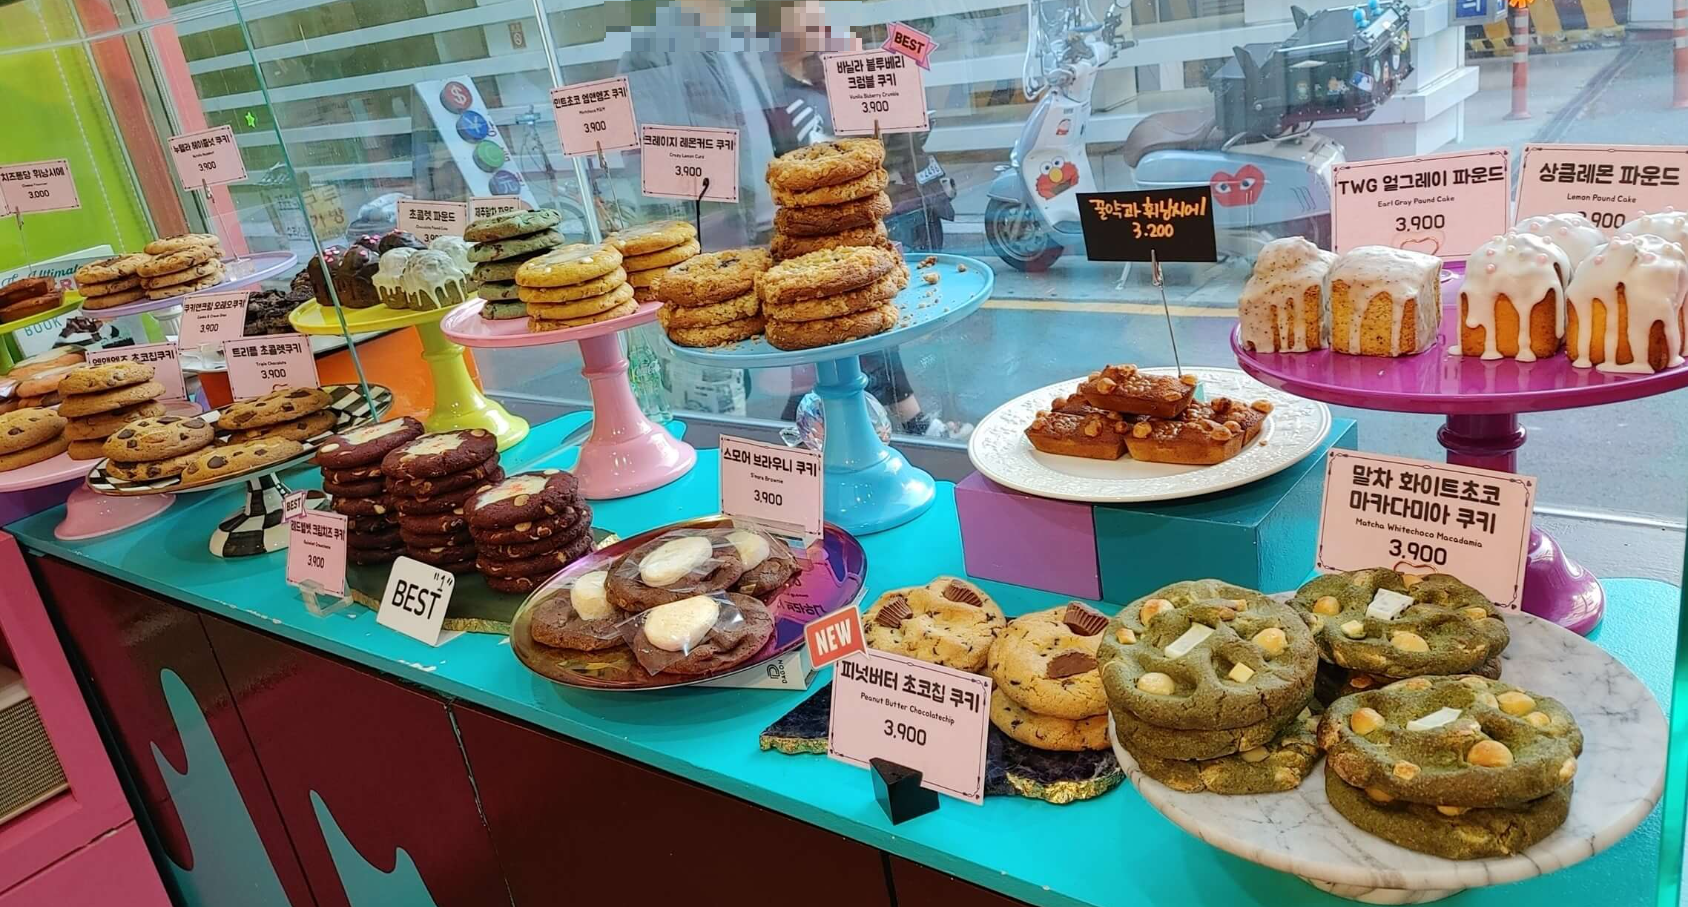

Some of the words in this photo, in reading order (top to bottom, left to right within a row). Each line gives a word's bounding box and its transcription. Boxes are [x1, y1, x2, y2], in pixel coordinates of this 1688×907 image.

[894, 32, 925, 54] BEST
[837, 59, 863, 74] 바닐라
[866, 55, 905, 72] 블루베리
[847, 76, 875, 89] 크럼블
[878, 73, 897, 87] 쿠키
[612, 87, 627, 99] 쿠키
[861, 100, 889, 113] 3.900
[584, 120, 606, 133] 3.900
[215, 134, 231, 144] 쿠키
[643, 135, 677, 147] 크레이지
[680, 137, 714, 149] 레몬커드
[716, 139, 733, 151] 쿠키
[33, 167, 65, 178] 휘낭시에
[198, 161, 216, 171] 3.900
[675, 165, 702, 177] 3.900
[1539, 163, 1614, 185] 상큼레몬
[1618, 165, 1680, 186] 파운드
[1338, 178, 1378, 195] TWG
[1382, 170, 1447, 192] 얼그레이
[1453, 166, 1505, 185] 파운드
[28, 190, 50, 199] 3.000
[1567, 193, 1591, 201] Lemon
[1592, 194, 1616, 202] Pound
[1617, 195, 1637, 203] Cake
[409, 208, 432, 221] 초콜렛
[433, 210, 456, 222] 파운드
[1089, 199, 1141, 220] 꿀약과
[1142, 196, 1207, 221] 휘낭시에
[1132, 221, 1174, 239] 3.200
[1395, 214, 1445, 232] 3.900
[200, 323, 219, 333] 3.900
[231, 346, 258, 357] 트리플
[261, 369, 287, 379] 3.900
[723, 447, 751, 465] 스모어
[753, 453, 792, 473] 브라우니
[796, 460, 817, 477] 쿠키
[1352, 464, 1393, 489] 말차
[1398, 471, 1501, 507] 화이트초코
[286, 497, 302, 512] BEST
[754, 489, 783, 506] 3.900
[1349, 490, 1451, 525] 마카다미아
[1456, 507, 1496, 535] 쿠키
[312, 524, 333, 539] 크림치즈
[334, 528, 345, 541] 쿠키
[1355, 517, 1385, 530] Matcha
[1388, 523, 1435, 539] Whitechoco
[1436, 532, 1483, 548] Macadamia
[1389, 538, 1448, 566] 3.900
[307, 554, 324, 569] 3.900
[391, 579, 442, 620] BEST
[814, 618, 852, 658] NEW
[840, 660, 898, 691] 피넛버터
[902, 674, 946, 704] 초코칩
[949, 687, 980, 714] 쿠키
[860, 692, 884, 705] Peanut
[885, 698, 908, 711] Butter
[883, 719, 928, 747] 3.900
